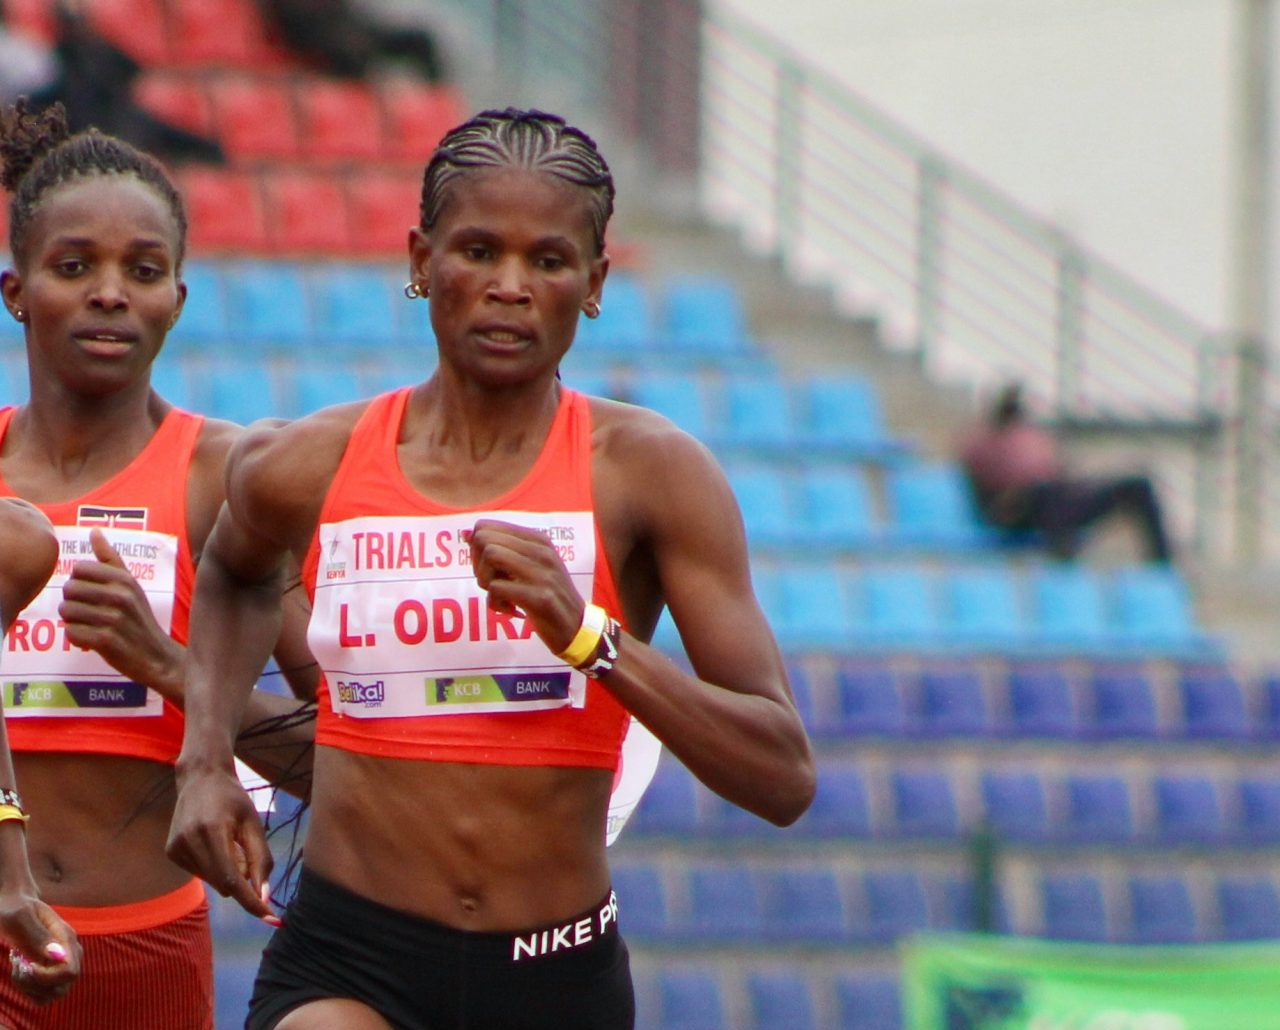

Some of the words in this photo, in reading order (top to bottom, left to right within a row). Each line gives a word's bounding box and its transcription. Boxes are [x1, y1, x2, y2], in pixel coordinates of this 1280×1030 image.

[535, 526, 575, 541] ETICS
[61, 540, 77, 554] THE
[352, 530, 453, 571] TRIALS
[554, 545, 575, 562] 25
[338, 604, 376, 648] L.
[26, 689, 53, 701] KCB
[89, 688, 125, 701] BANK
[453, 682, 481, 696] KCB
[516, 681, 550, 694] BANK
[513, 917, 593, 961] NIKE
[599, 889, 619, 935] PR
